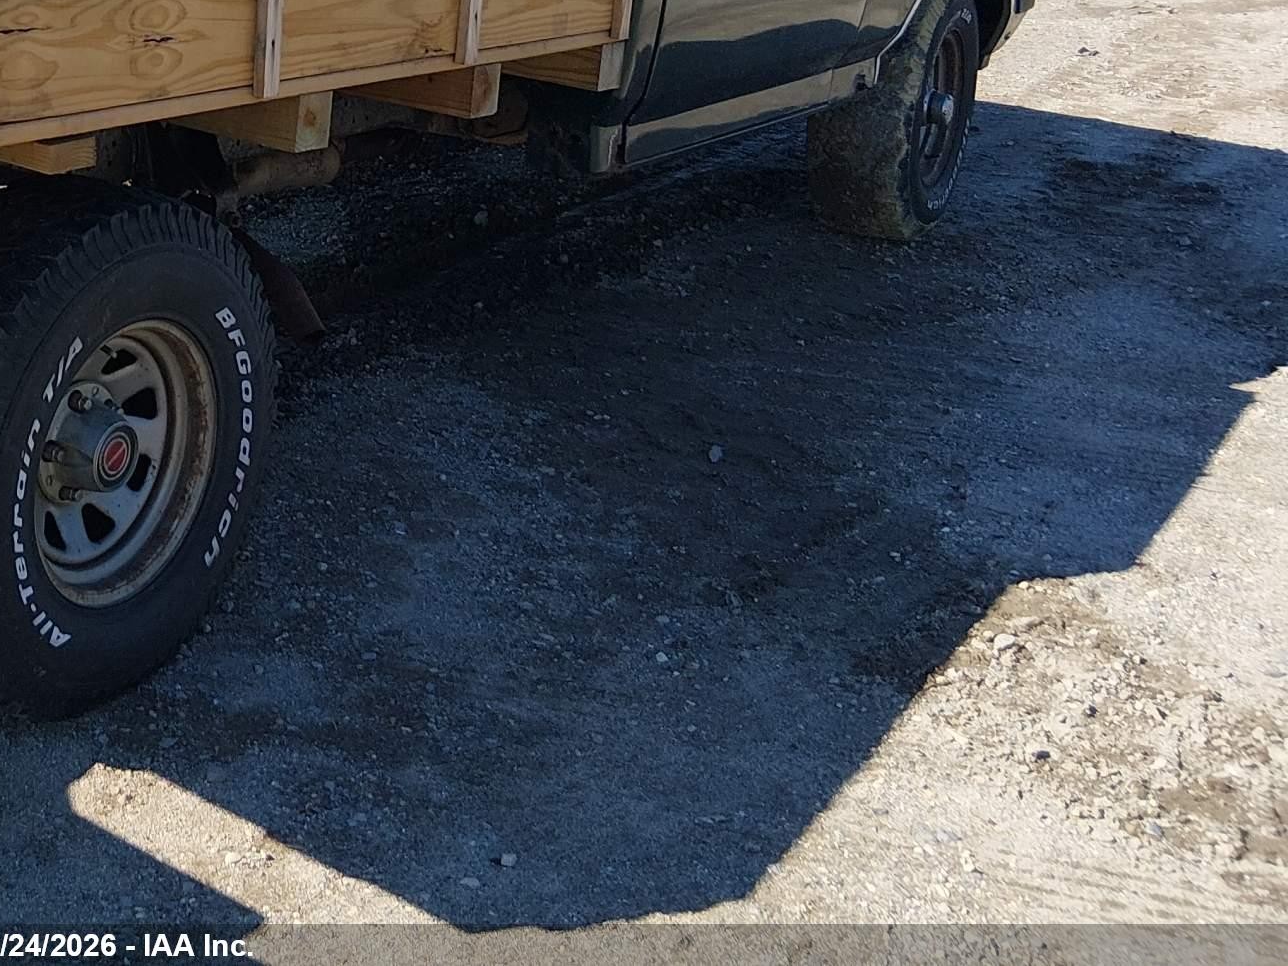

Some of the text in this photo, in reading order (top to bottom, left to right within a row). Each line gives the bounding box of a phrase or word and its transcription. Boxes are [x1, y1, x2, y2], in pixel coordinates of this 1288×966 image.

[12, 336, 83, 648] All-Terrain T/A
[204, 307, 253, 567] BFGoodrich
